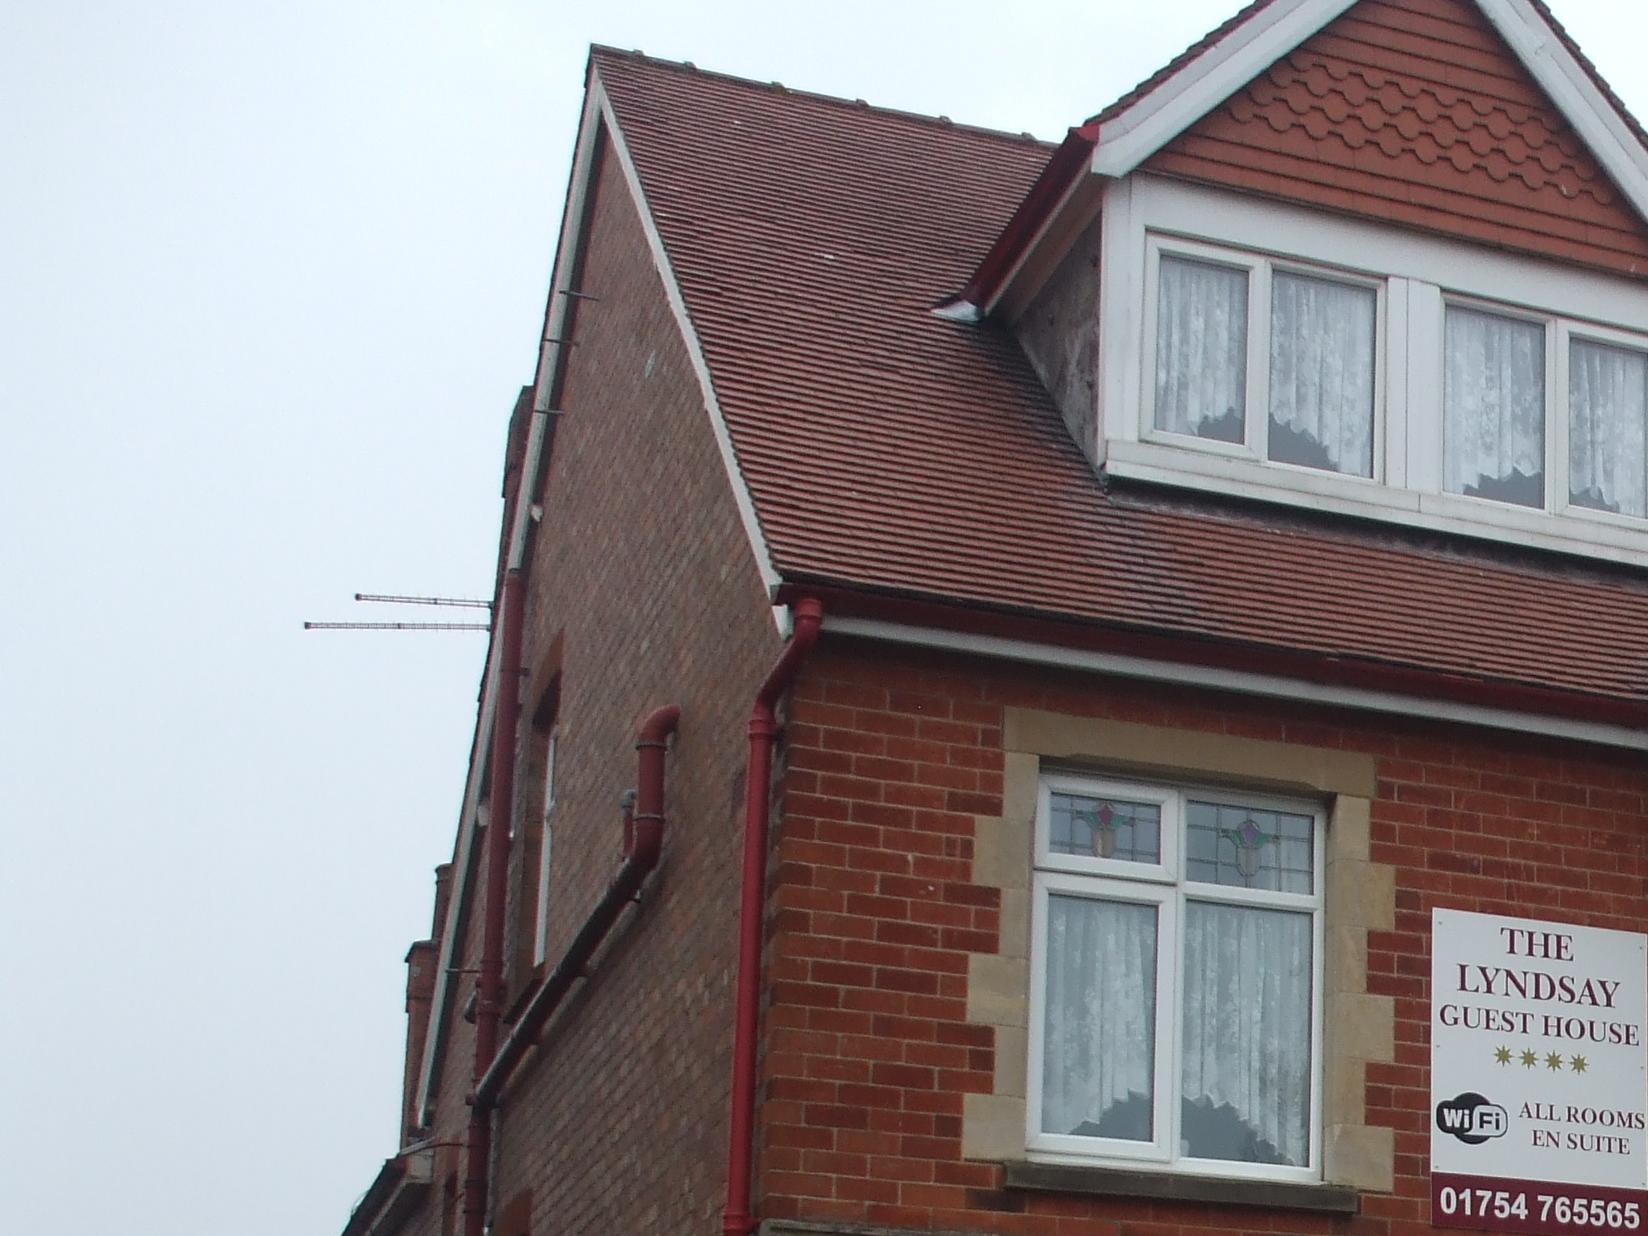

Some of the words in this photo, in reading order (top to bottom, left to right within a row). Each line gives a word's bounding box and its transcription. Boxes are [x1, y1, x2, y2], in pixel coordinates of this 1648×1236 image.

[1500, 927, 1574, 962] THE
[1457, 963, 1620, 1008] LYNDSAY
[1439, 1004, 1534, 1035] GUEST
[1541, 1014, 1640, 1046] HOUSE
[1519, 1101, 1561, 1122] ALL
[1566, 1106, 1645, 1130] ROOMS
[1531, 1129, 1561, 1150] EN
[1566, 1132, 1631, 1155] SUITE
[1440, 1186, 1528, 1220] 01754
[1537, 1195, 1641, 1229] 765565
